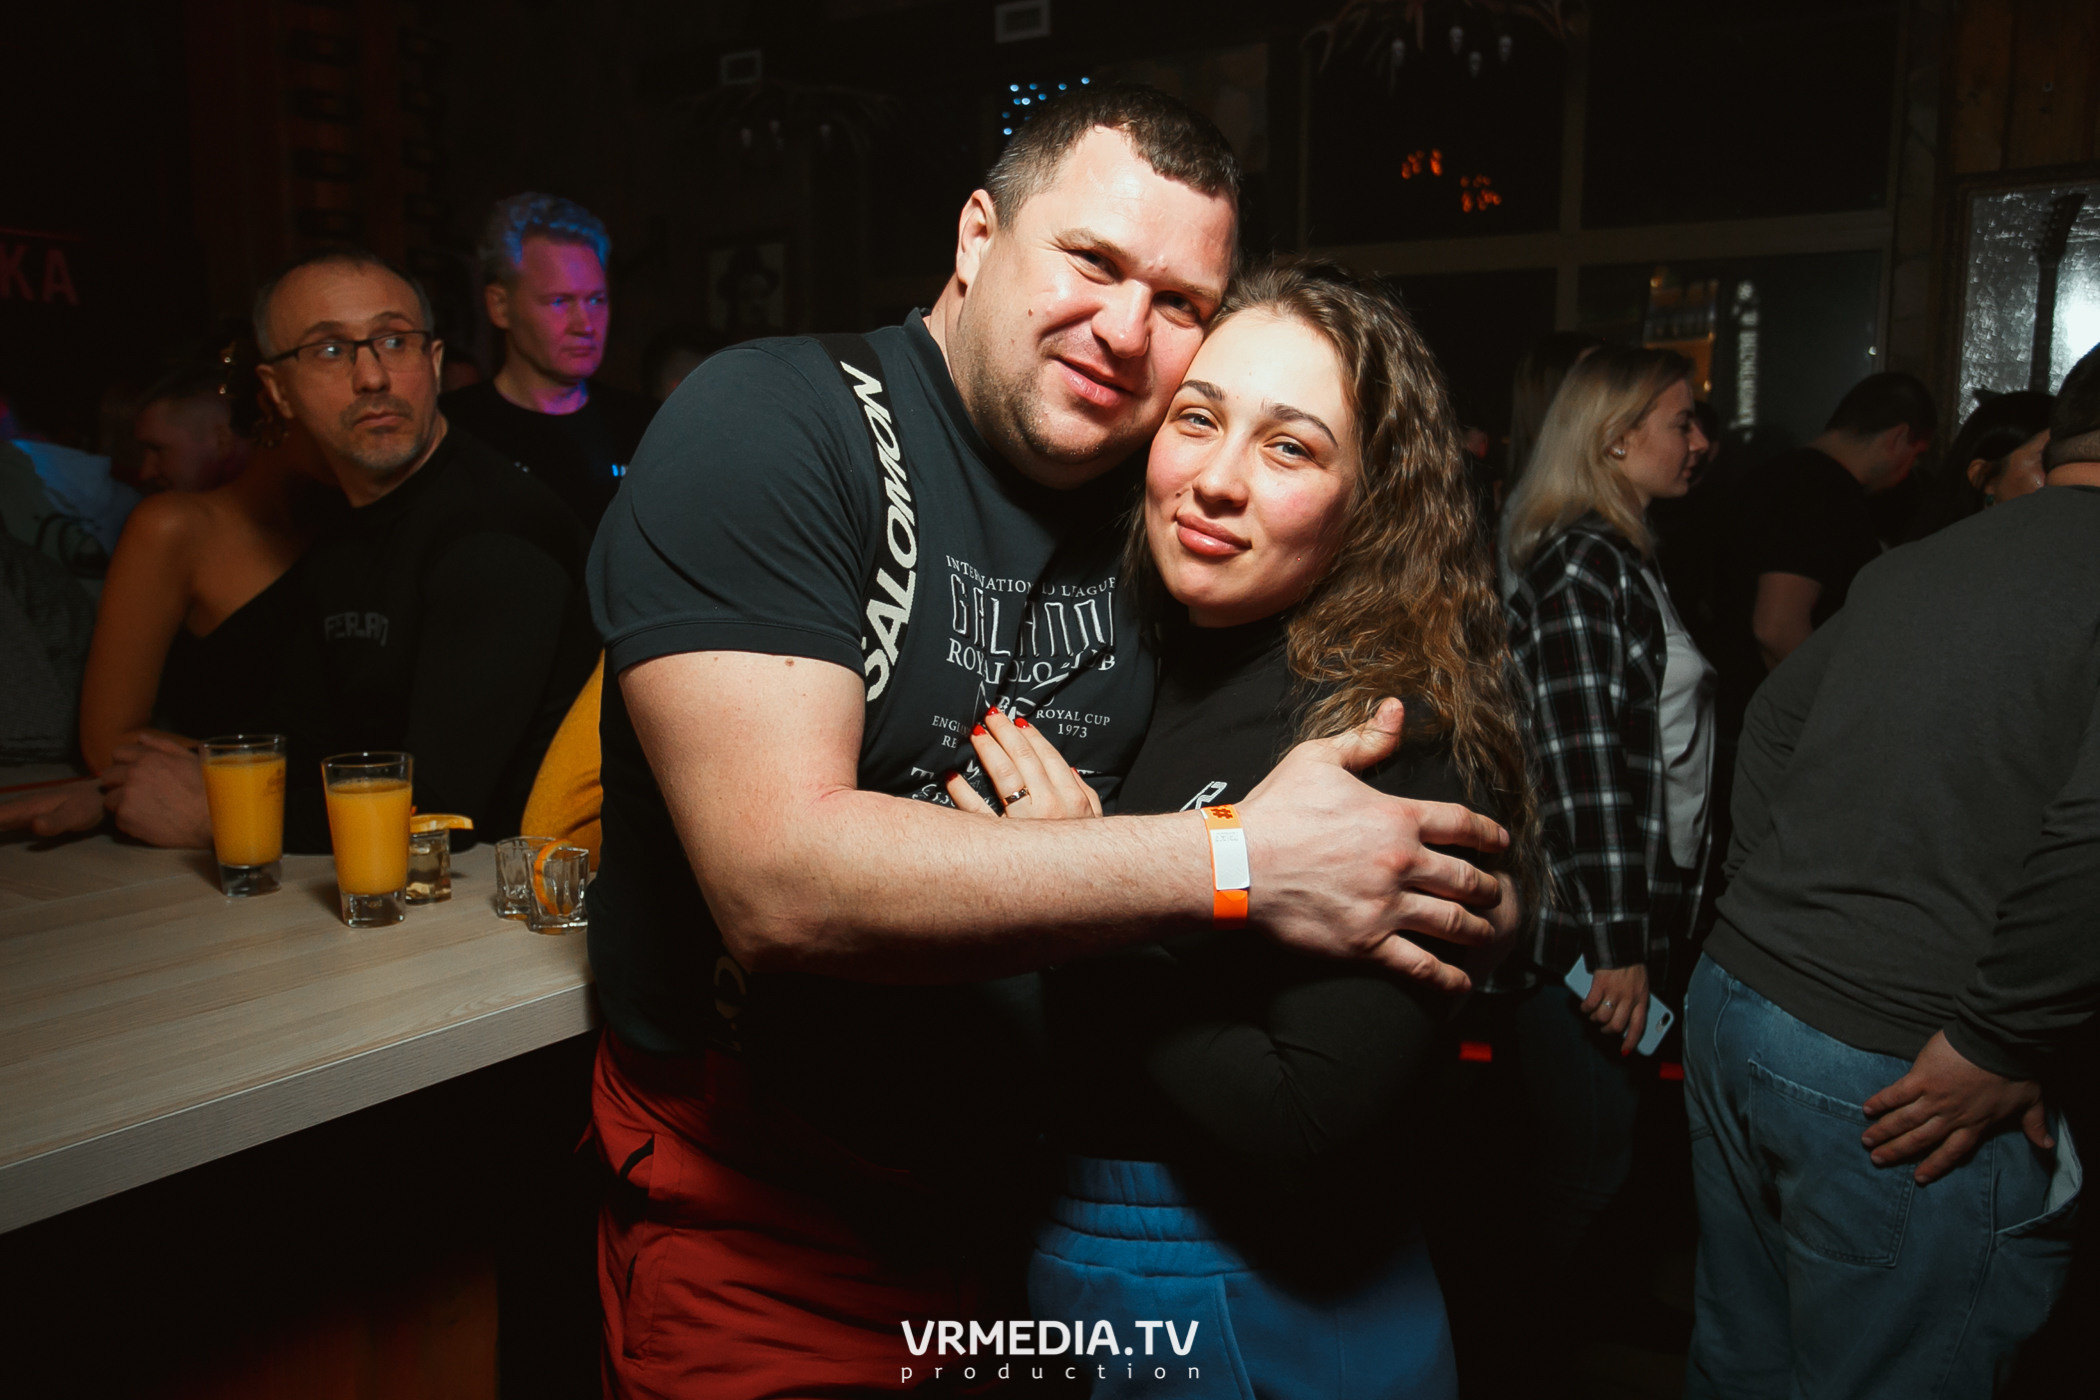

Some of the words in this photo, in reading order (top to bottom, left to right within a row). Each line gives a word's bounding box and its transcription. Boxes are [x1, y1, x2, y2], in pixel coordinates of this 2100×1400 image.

[840, 361, 918, 702] SALOMON
[945, 555, 1036, 595] INTERNATION
[1035, 708, 1081, 722] ROYAL
[1084, 713, 1111, 727] CUP
[1057, 723, 1088, 739] 1973
